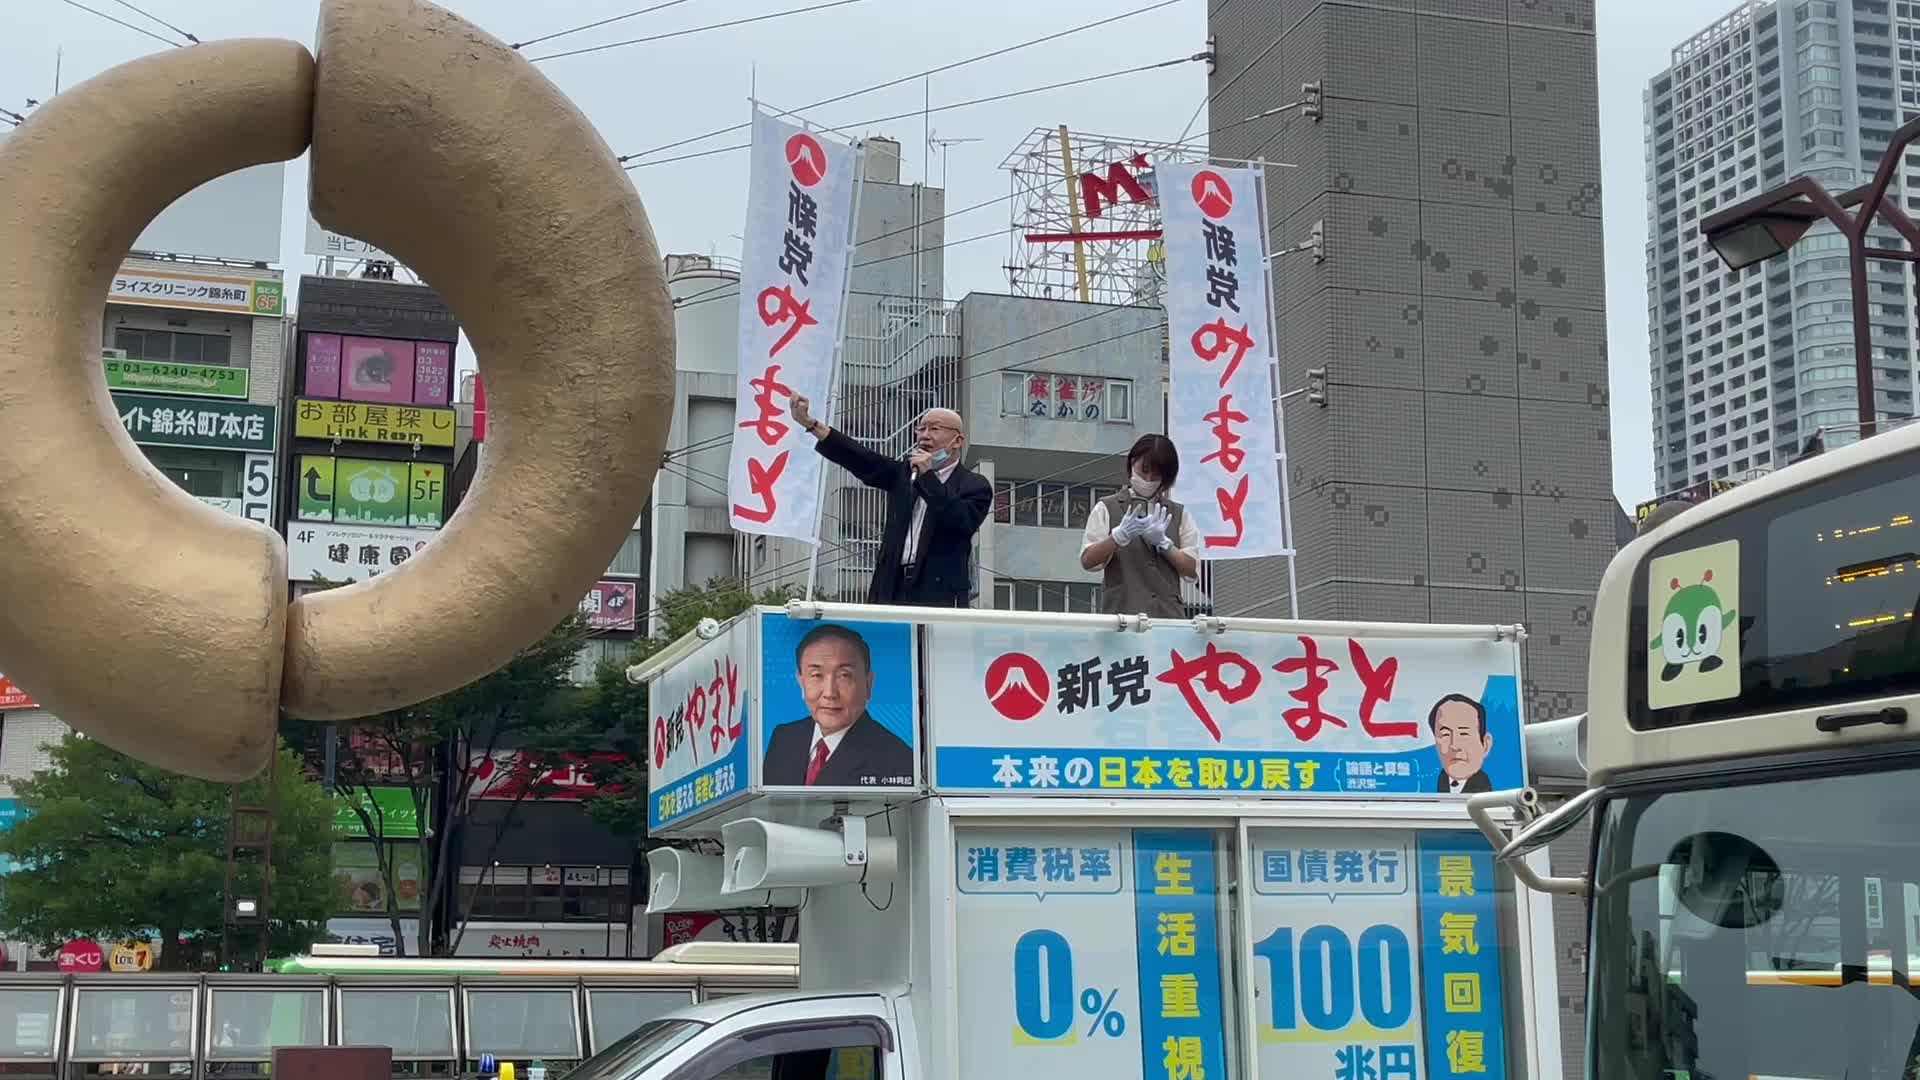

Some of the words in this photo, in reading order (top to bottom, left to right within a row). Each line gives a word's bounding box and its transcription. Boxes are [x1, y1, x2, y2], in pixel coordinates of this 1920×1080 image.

[115, 279, 247, 301] ライズクリニック錦糸町
[256, 294, 279, 310] 6F
[300, 402, 450, 430] お部屋探し
[1030, 399, 1100, 419] なかの
[326, 424, 368, 438] Link
[377, 428, 424, 442] Room
[413, 480, 441, 501] 5F
[297, 530, 316, 544] 4F
[327, 542, 412, 566] 健康園
[608, 595, 625, 608] 4F
[991, 756, 1322, 790] 本来の日本を取り戻す
[967, 847, 1113, 883] 消費税率
[1262, 849, 1400, 885] 国債発行
[60, 952, 101, 966] 宝くじ
[1153, 851, 1206, 1080] 生活重視
[1437, 855, 1487, 1075] 景気回復
[1253, 923, 1413, 1031] 100
[1335, 1044, 1417, 1080] 兆円
